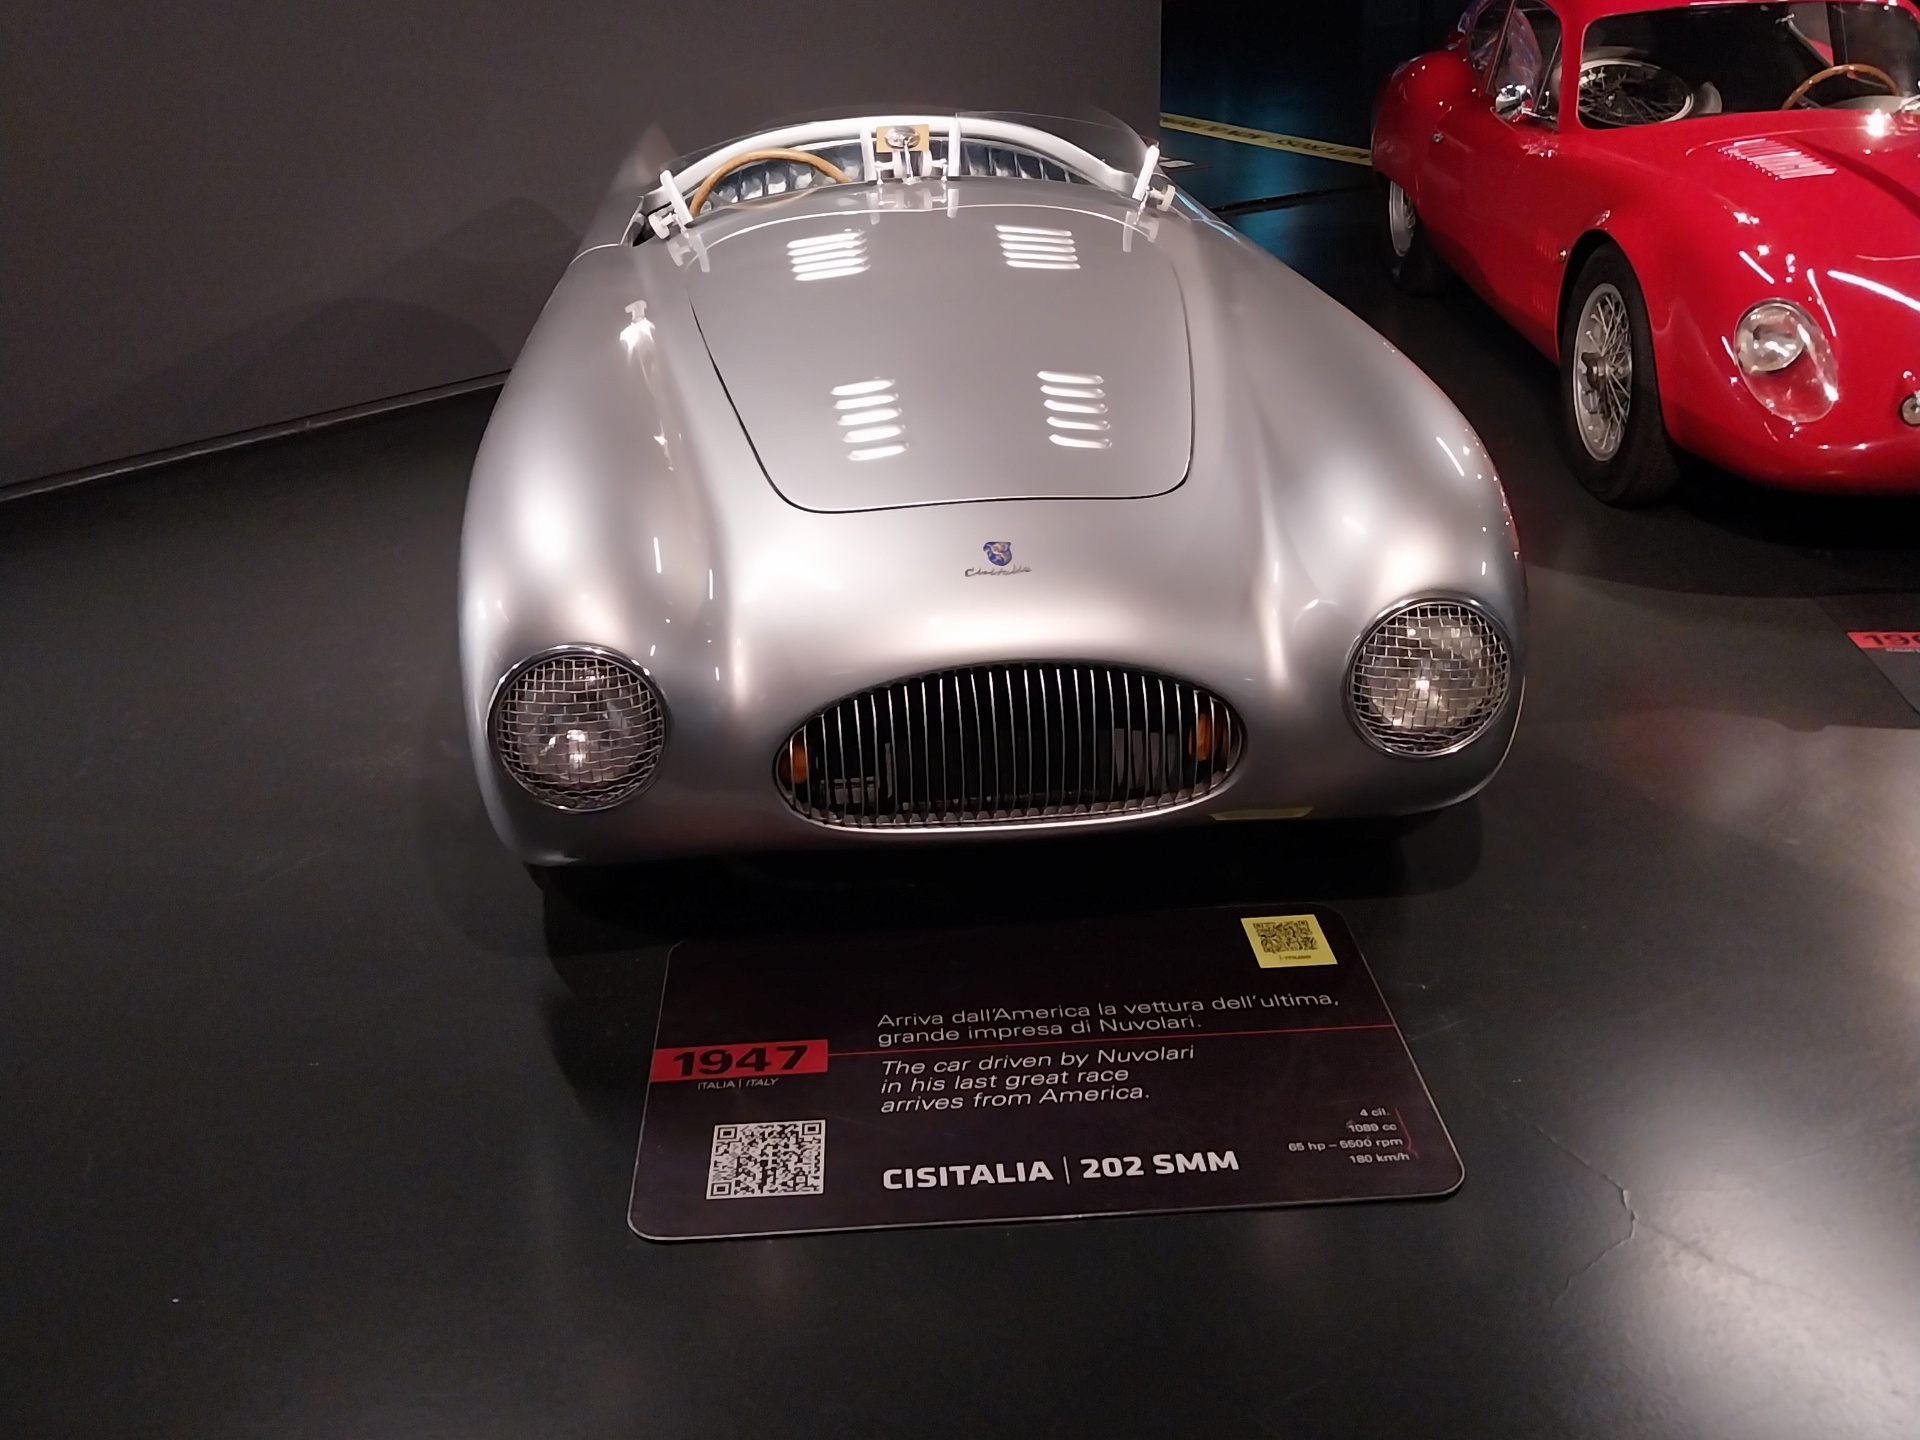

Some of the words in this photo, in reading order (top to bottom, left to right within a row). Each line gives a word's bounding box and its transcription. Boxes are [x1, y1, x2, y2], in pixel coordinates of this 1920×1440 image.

[877, 1013, 943, 1027] Arriva
[952, 1005, 1090, 1024] dall'America
[1098, 1003, 1117, 1016] la
[1124, 1001, 1204, 1014] vettura
[878, 1028, 959, 1048] grande
[968, 1024, 1063, 1040] impresa
[1071, 1018, 1091, 1033] di
[1100, 1014, 1202, 1033] Nuvolari.
[673, 1045, 808, 1077] 1947
[882, 1060, 926, 1076] The
[933, 1060, 971, 1072] car
[978, 1054, 1051, 1070] driven
[1061, 1052, 1089, 1068] by
[1098, 1044, 1194, 1064] Nuvolari
[698, 1080, 735, 1090] ITALIA
[745, 1077, 779, 1087] ITALY
[881, 1078, 902, 1094] in
[911, 1077, 946, 1092] his
[955, 1075, 998, 1091] last
[1005, 1069, 1069, 1090] great
[1077, 1069, 1129, 1084] race
[881, 1096, 964, 1113] arrives
[973, 1091, 1032, 1108] from
[1039, 1085, 1150, 1104] America.
[1360, 1108, 1369, 1117] 4
[1371, 1107, 1391, 1117] cil.
[1382, 1123, 1397, 1132] cc
[1308, 1142, 1326, 1152] hp
[1376, 1138, 1404, 1148] rpm
[1376, 1152, 1410, 1163] km/h
[882, 1160, 1054, 1190] CISITALIA
[1080, 1156, 1145, 1179] 202
[1152, 1150, 1239, 1175] SMM
